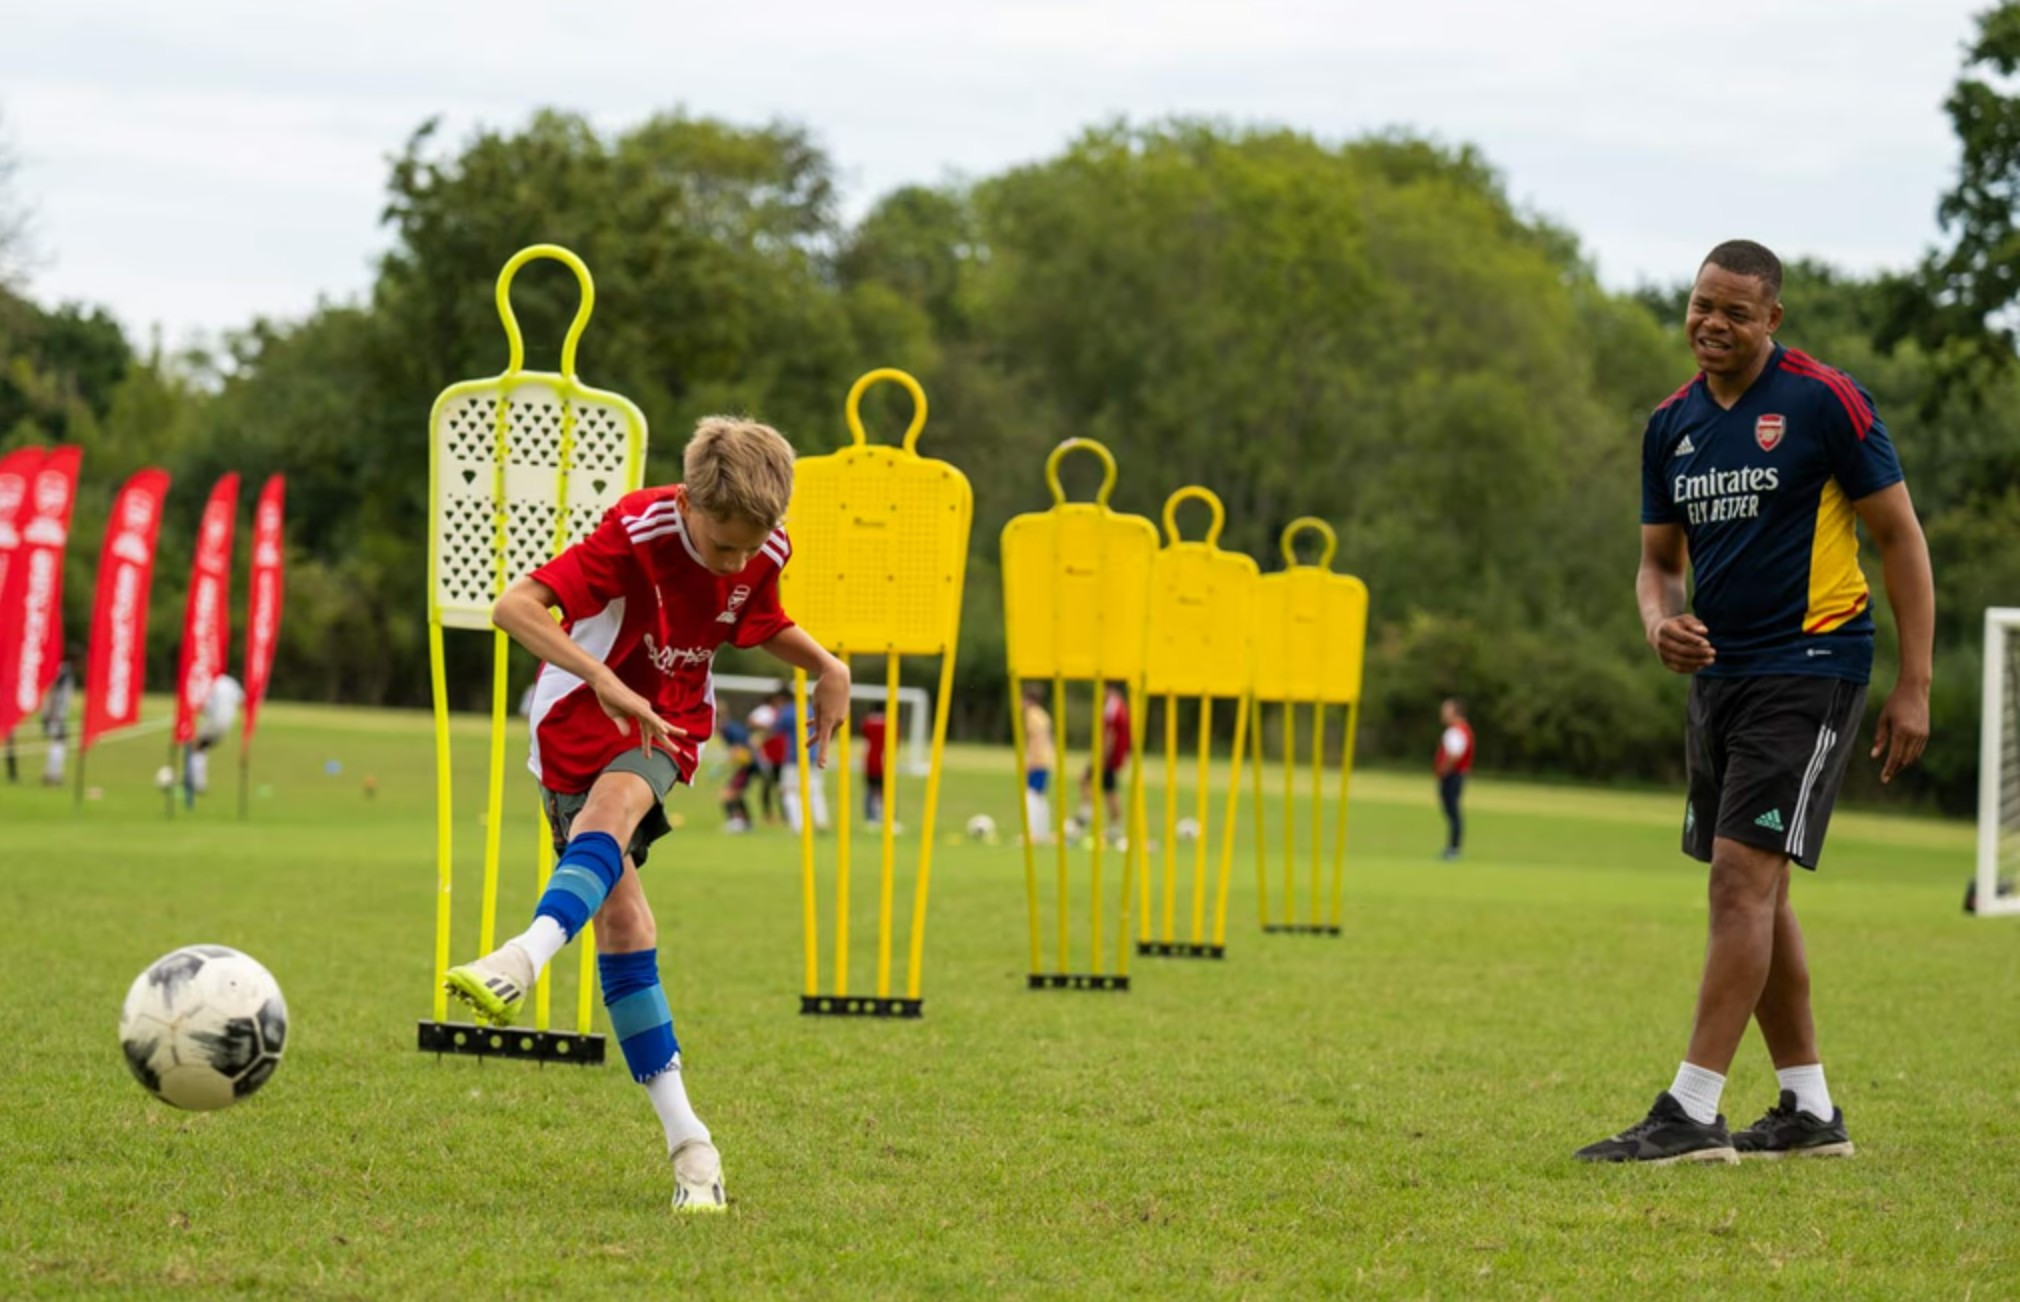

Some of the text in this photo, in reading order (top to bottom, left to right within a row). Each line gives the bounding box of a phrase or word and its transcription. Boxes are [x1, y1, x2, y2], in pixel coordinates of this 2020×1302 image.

[1674, 466, 1779, 503] Emirates
[1687, 494, 1760, 525] FLY BETTER
